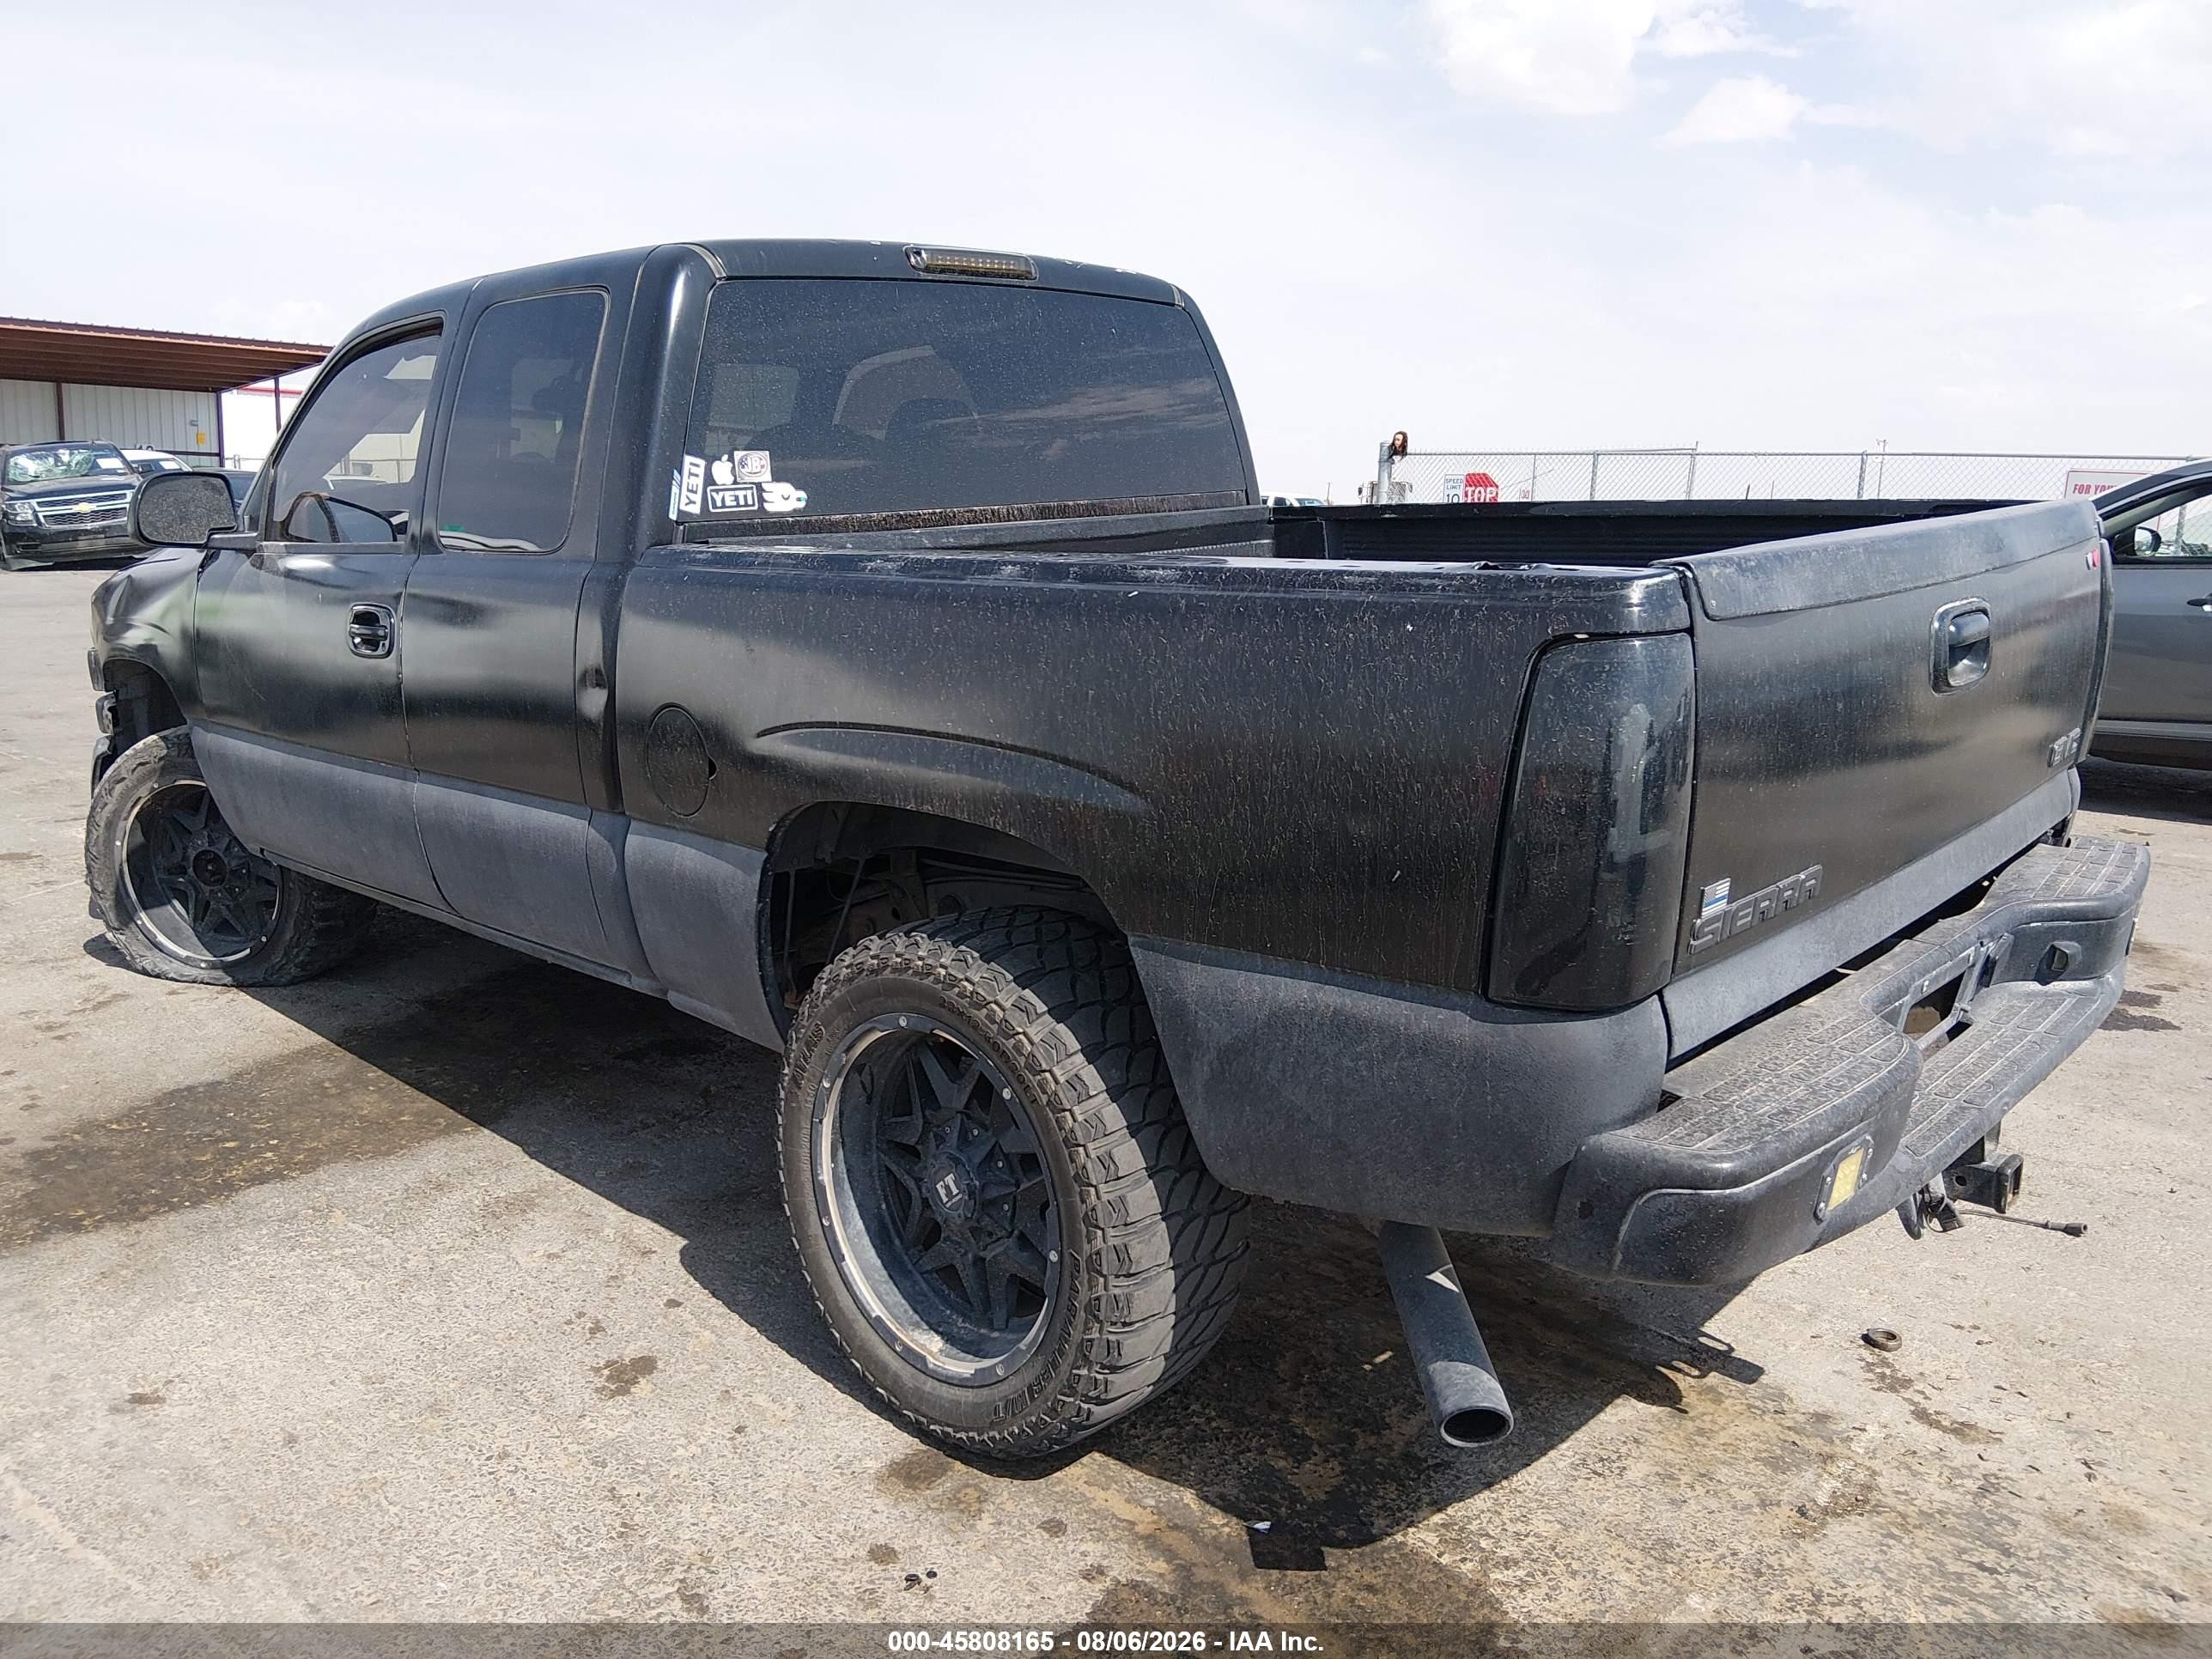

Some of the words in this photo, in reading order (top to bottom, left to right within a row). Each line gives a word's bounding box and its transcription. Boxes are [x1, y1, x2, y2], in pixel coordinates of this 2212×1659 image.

[684, 461, 702, 507] YETI
[710, 489, 753, 507] YETI
[2073, 483, 2092, 495] FOR
[1686, 864, 1823, 956] SIERRA
